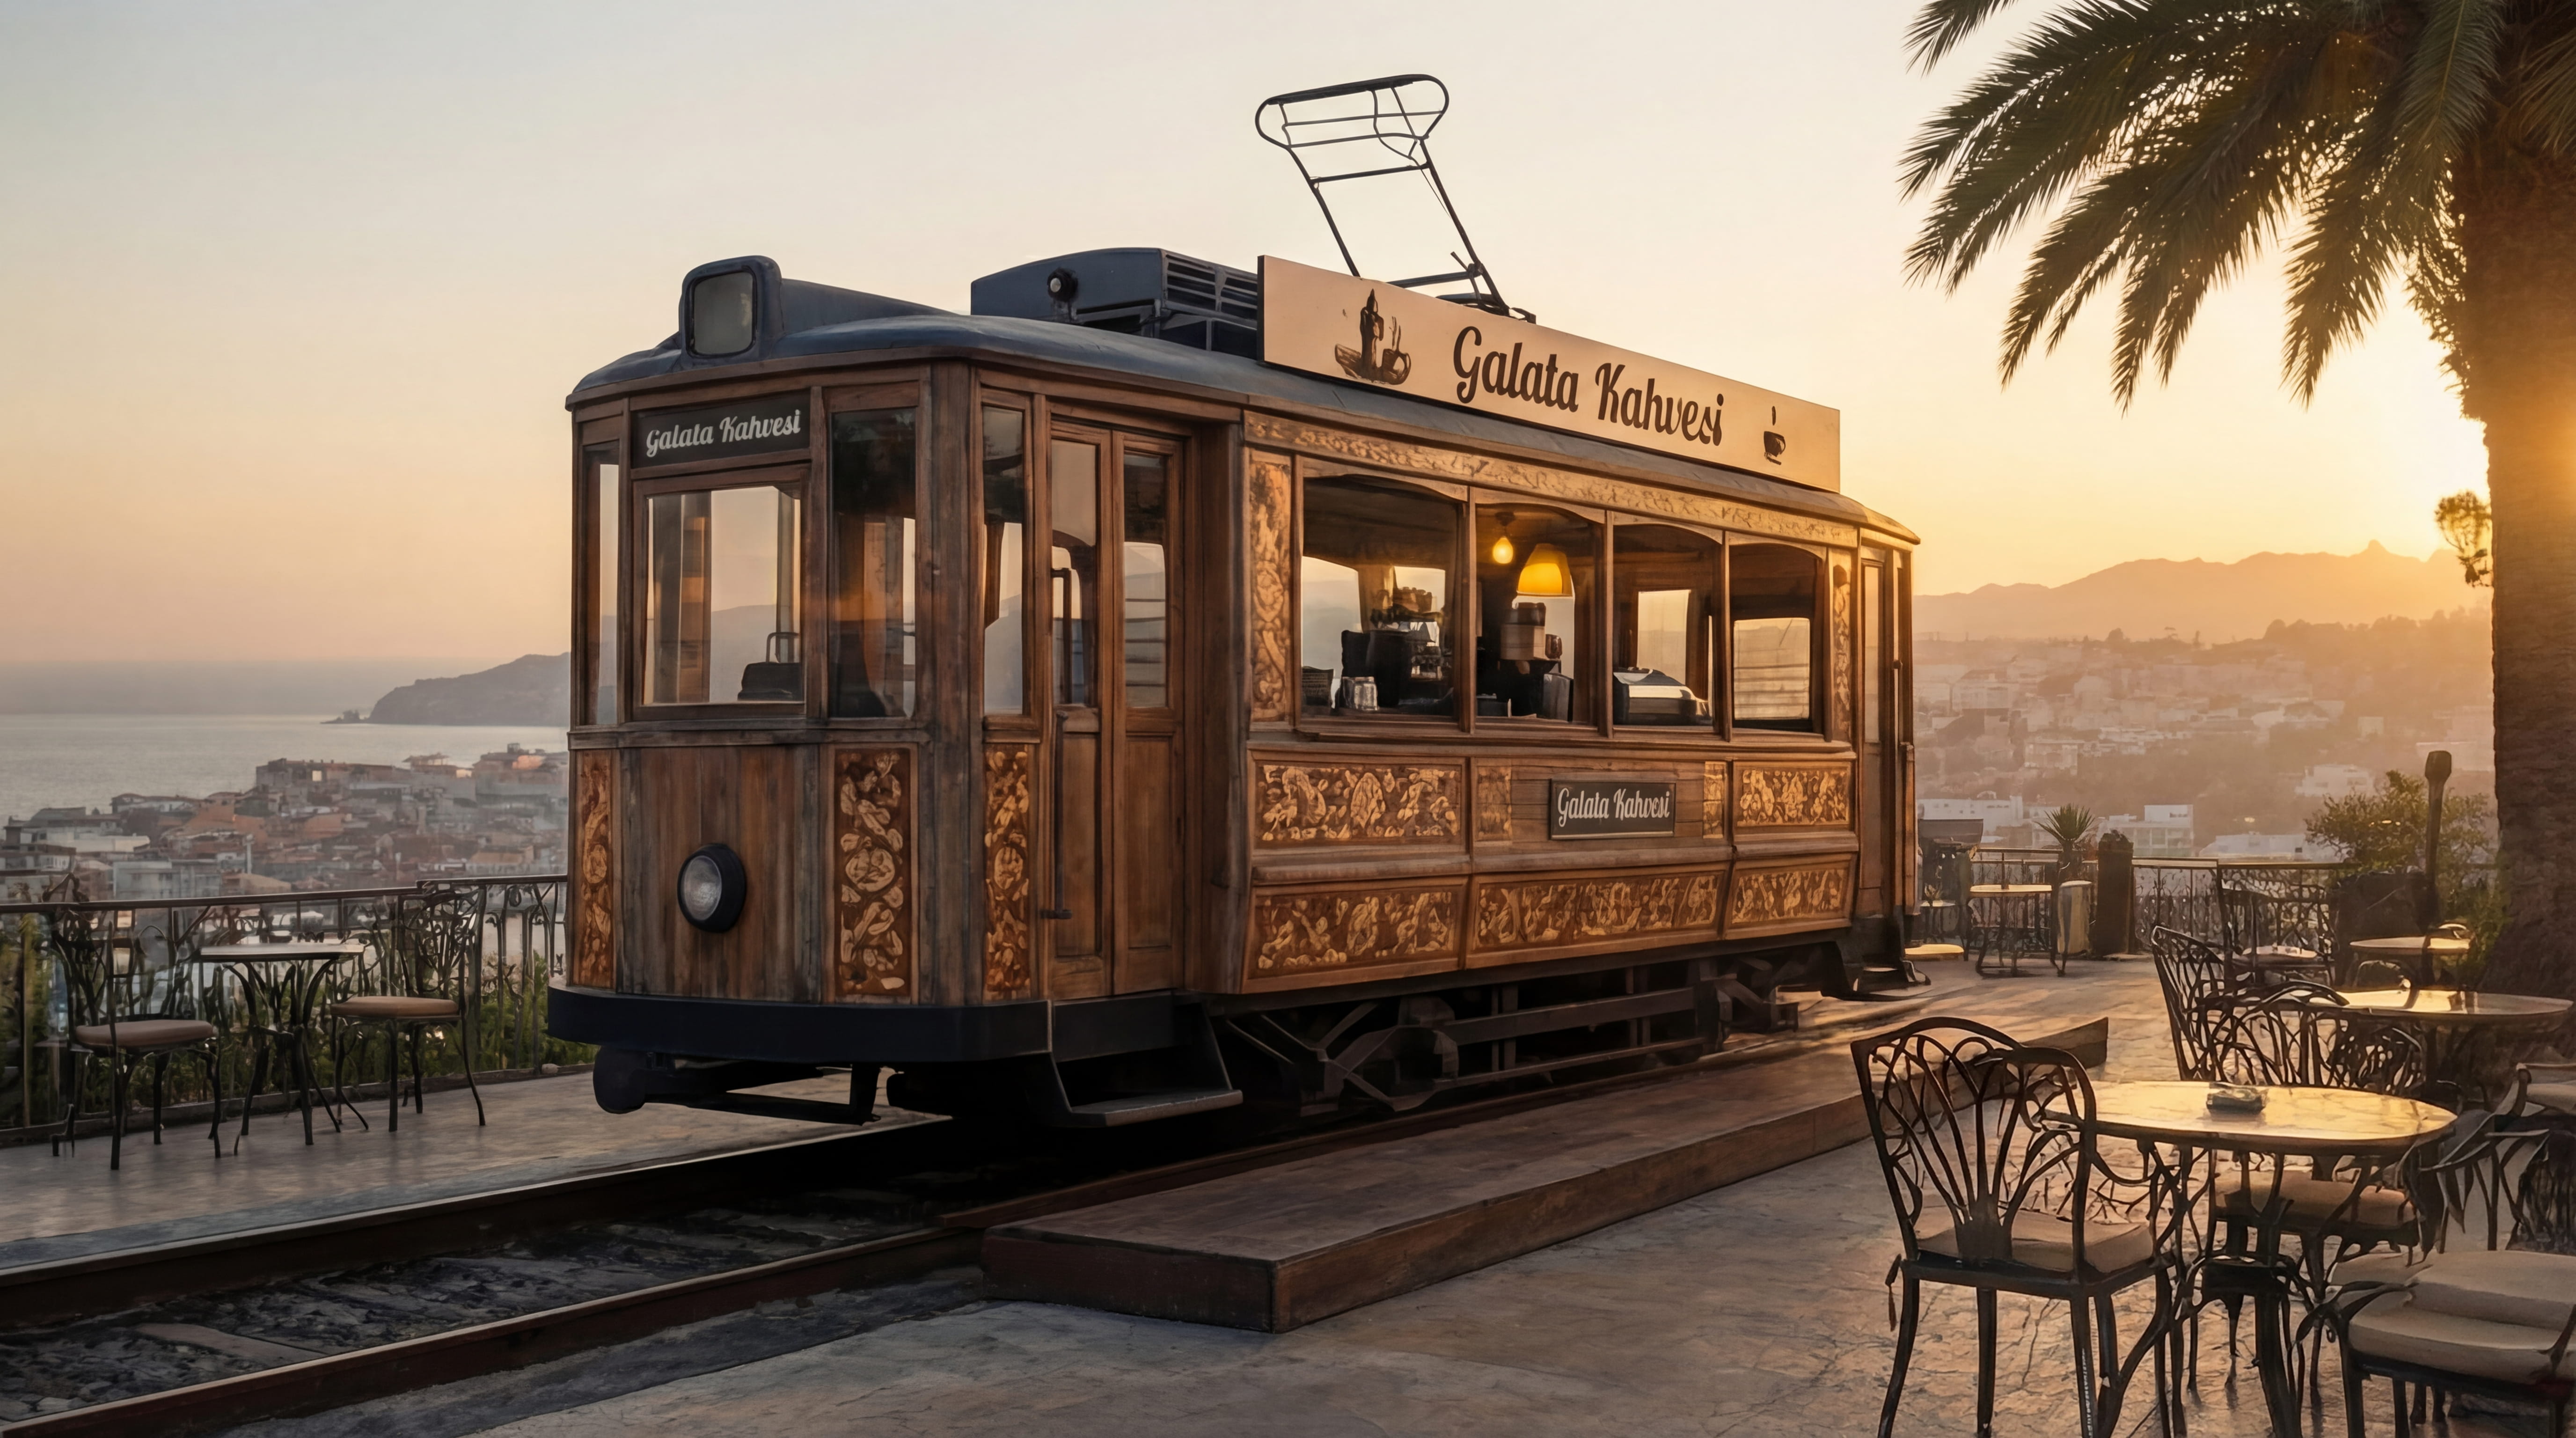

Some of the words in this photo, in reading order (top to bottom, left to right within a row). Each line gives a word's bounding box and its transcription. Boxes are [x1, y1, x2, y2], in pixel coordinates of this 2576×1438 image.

[1453, 326, 1579, 413] Galata
[1595, 362, 1724, 447] Kahvesi
[646, 423, 714, 457] Galata
[719, 409, 801, 443] Kahvesi
[1558, 787, 1610, 828] Galata
[1613, 788, 1670, 821] Kahvesi
